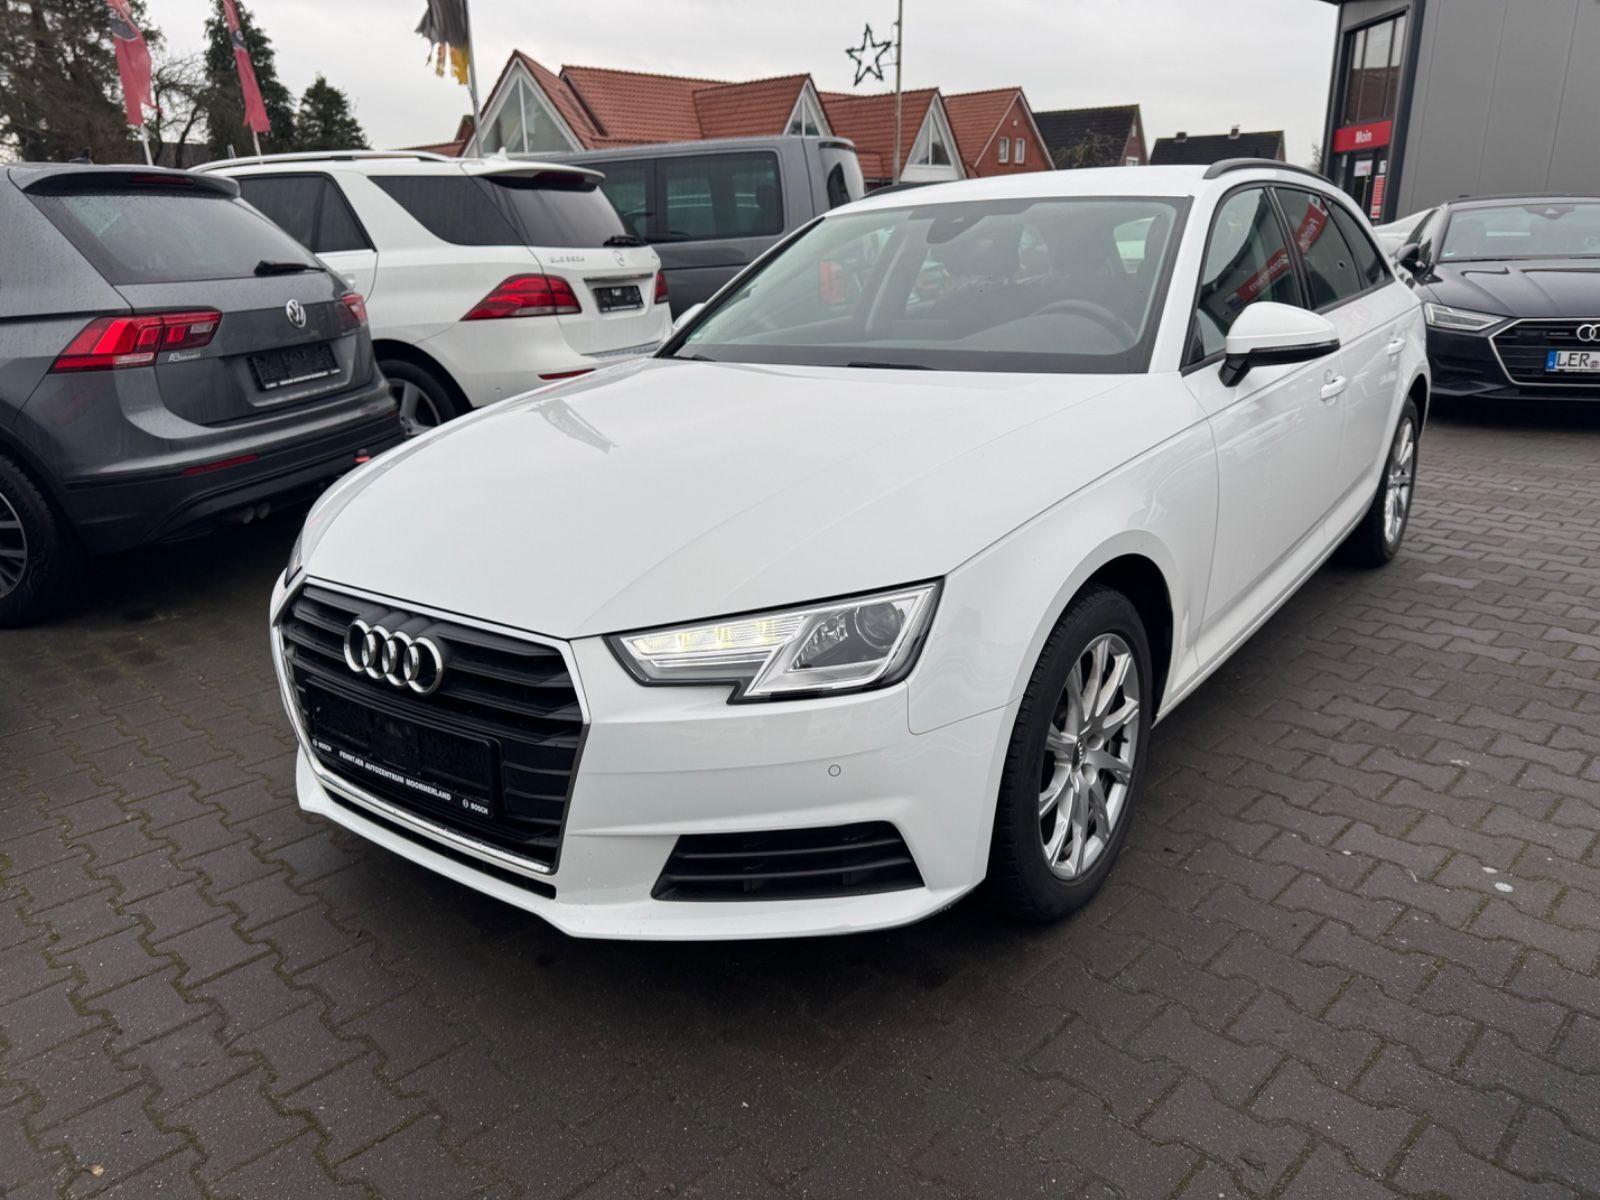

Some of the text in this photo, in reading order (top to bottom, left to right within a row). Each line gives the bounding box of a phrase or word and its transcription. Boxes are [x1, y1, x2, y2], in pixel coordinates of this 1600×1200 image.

[1355, 130, 1372, 144] Moin
[1557, 352, 1590, 367] LER
[365, 762, 404, 784] AUTOZENTRUM
[406, 778, 452, 801] MOORMERLAND
[470, 802, 489, 815] BOSCH
